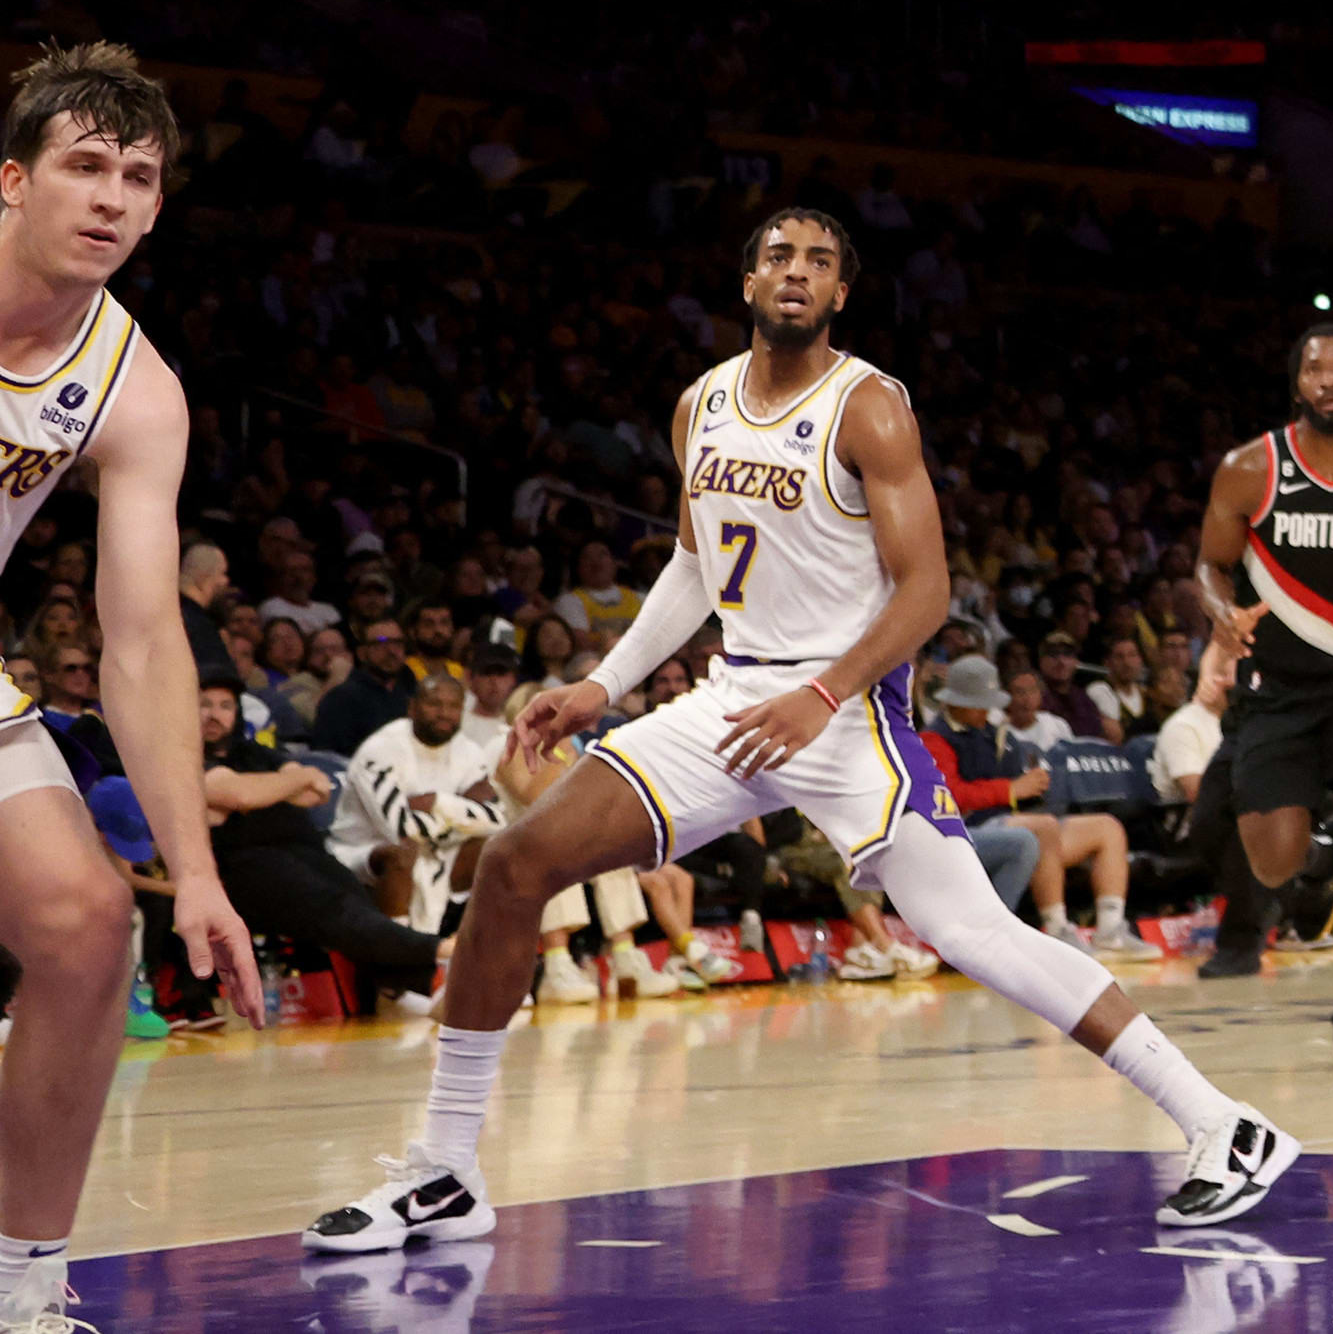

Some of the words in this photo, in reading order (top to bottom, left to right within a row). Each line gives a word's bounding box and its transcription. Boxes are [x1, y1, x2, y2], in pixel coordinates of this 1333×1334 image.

[1169, 107, 1250, 134] EXPRESS
[40, 403, 87, 434] bibigo
[689, 445, 807, 511] LAKERS
[719, 521, 759, 610] 7
